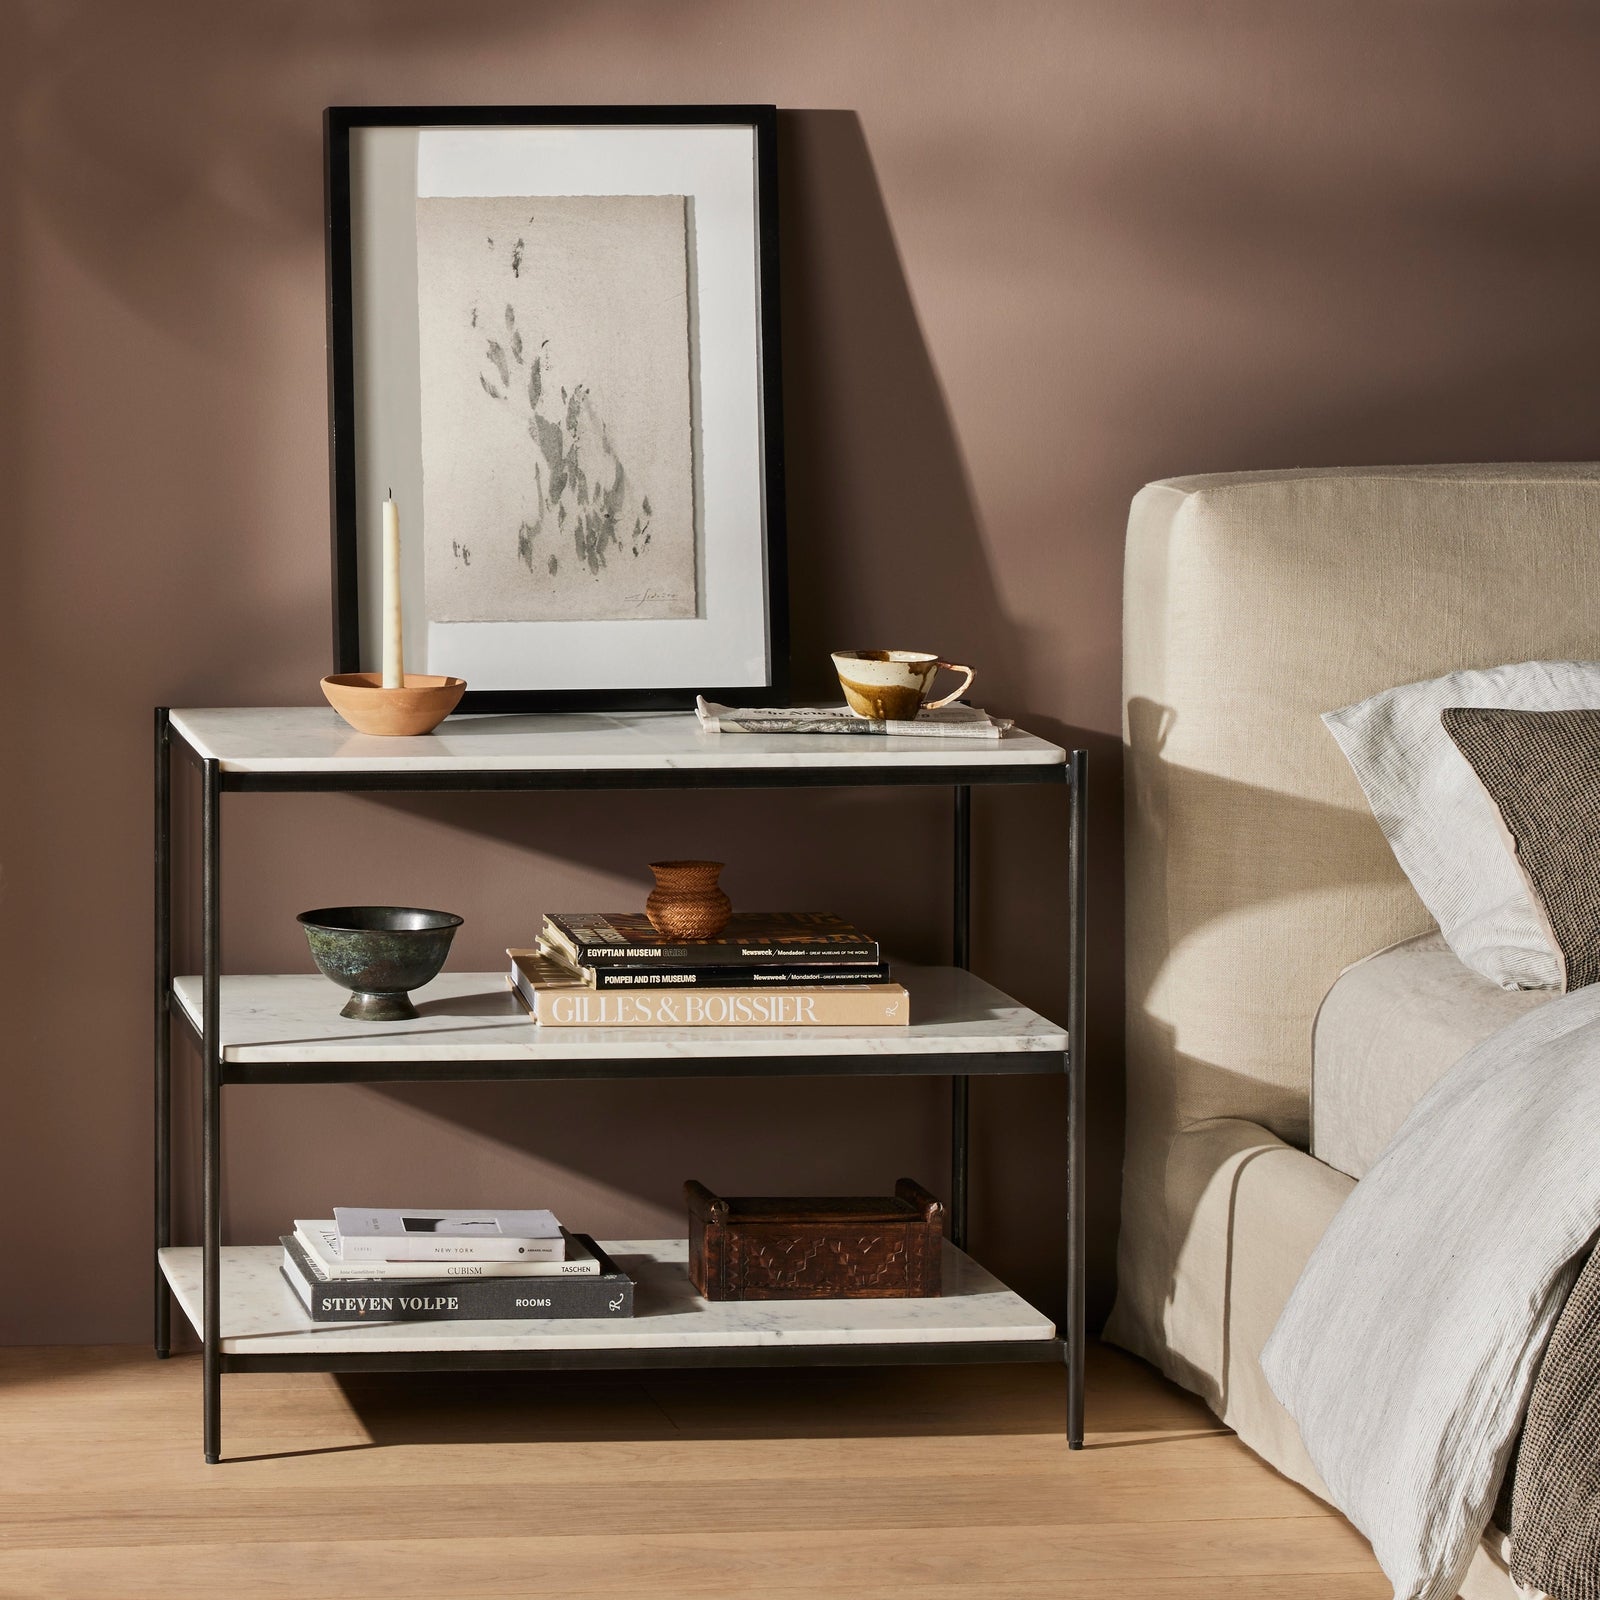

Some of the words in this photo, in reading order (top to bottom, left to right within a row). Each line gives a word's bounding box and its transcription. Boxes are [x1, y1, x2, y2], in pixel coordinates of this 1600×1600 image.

[587, 948, 625, 957] EGYPTIAN
[626, 948, 661, 957] MUSEUM
[604, 976, 633, 984] POMPEII
[634, 975, 649, 984] AND
[650, 975, 660, 983] ITS
[662, 975, 696, 983] MUSEUMS
[552, 996, 651, 1023] GILLES
[656, 996, 680, 1023] &
[685, 996, 820, 1023] BOISSIER
[447, 1267, 482, 1275] CUBISM
[322, 1297, 394, 1311] STEVEN
[398, 1297, 459, 1311] VOLPE
[516, 1298, 551, 1307] ROOMS
